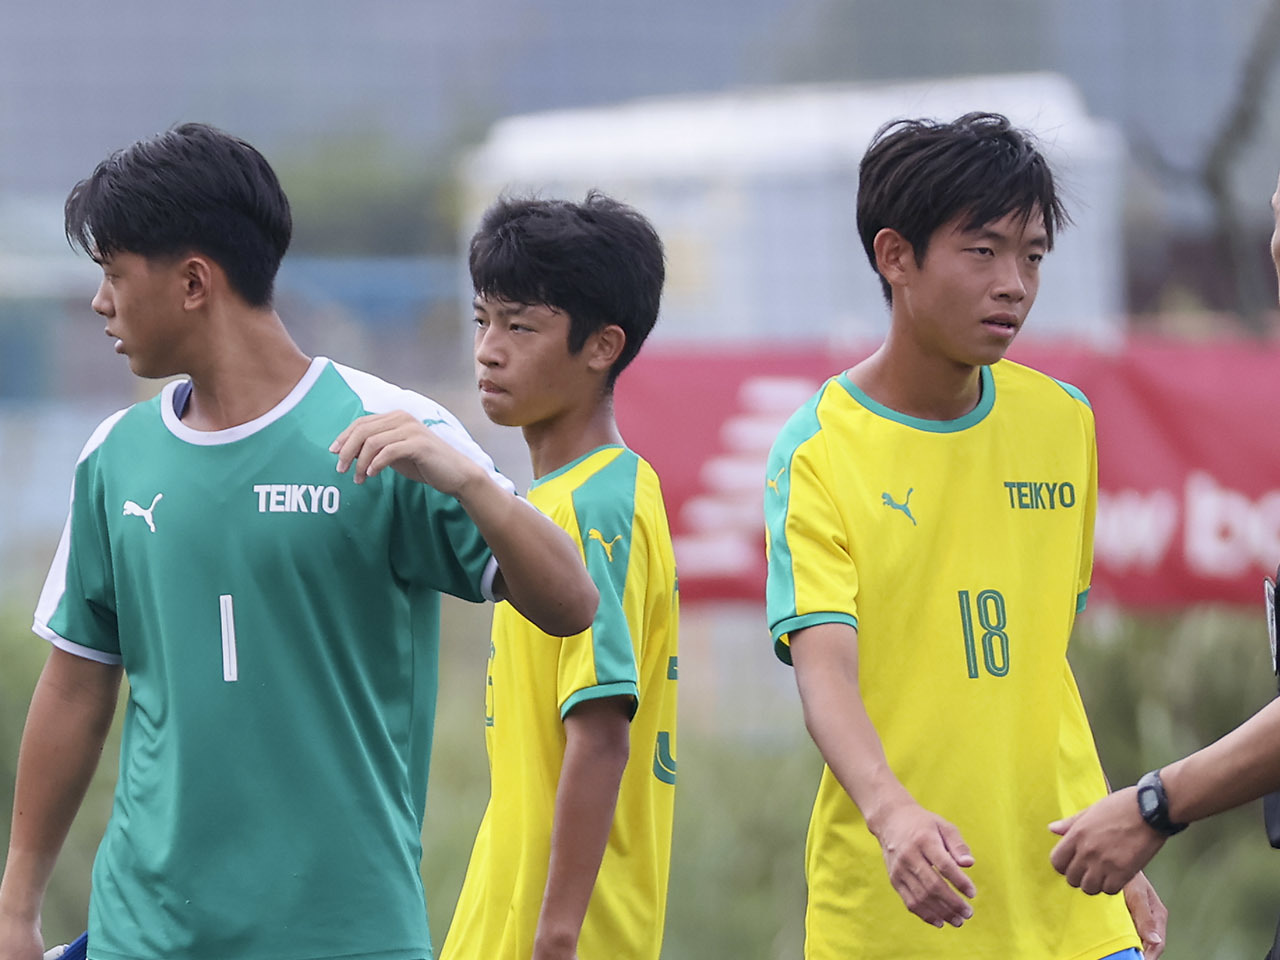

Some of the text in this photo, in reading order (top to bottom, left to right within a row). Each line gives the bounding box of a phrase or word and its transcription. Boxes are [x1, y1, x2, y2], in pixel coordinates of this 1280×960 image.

[253, 484, 340, 514] TEIKYO
[1003, 481, 1076, 511] TEIKYO
[219, 594, 238, 682] 1
[957, 588, 1010, 680] 18
